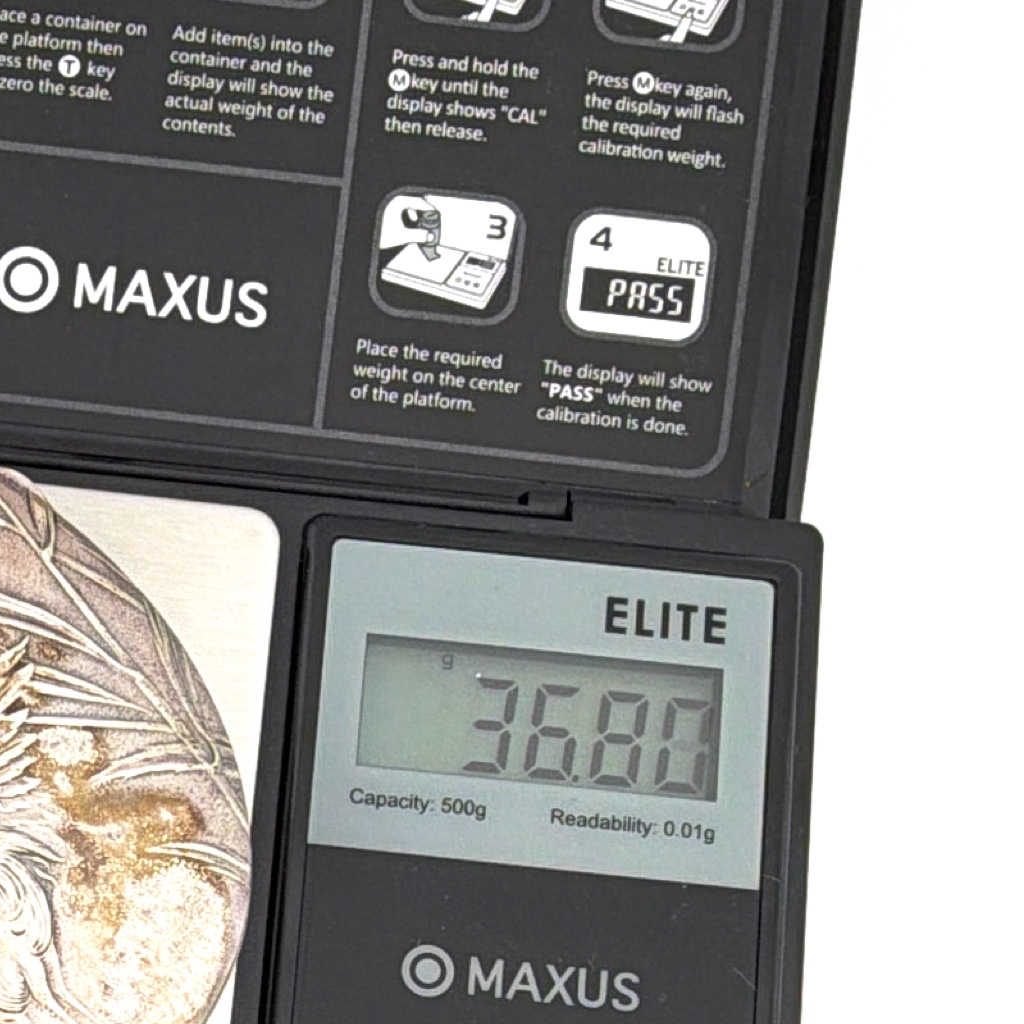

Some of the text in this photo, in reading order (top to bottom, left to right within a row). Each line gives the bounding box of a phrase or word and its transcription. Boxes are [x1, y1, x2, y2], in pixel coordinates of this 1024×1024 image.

[30, 12, 40, 25] a
[45, 12, 122, 36] container
[126, 22, 148, 37] on
[12, 30, 81, 52] platform
[87, 39, 124, 57] then
[172, 25, 335, 58] Add item(s) into the
[26, 54, 53, 72] the
[87, 61, 116, 81] key
[170, 50, 313, 78] container and the
[393, 49, 539, 80] Press and hold the
[38, 79, 65, 96] the
[69, 83, 113, 101] scale.
[167, 72, 335, 102] display will show the
[411, 76, 439, 96] key
[442, 80, 478, 96] until
[482, 82, 509, 98] the
[587, 70, 629, 90] Press
[654, 78, 682, 97] key
[685, 83, 733, 103] again,
[164, 95, 326, 124] actual weight of the
[386, 94, 547, 125] display shows "CAL"
[585, 93, 744, 125] the display will flash
[161, 118, 236, 138] contents.
[384, 118, 487, 142] then release.
[582, 116, 681, 143] the required
[578, 139, 726, 169] calibration weight.
[485, 214, 507, 239] 3
[590, 226, 613, 251] 4
[657, 257, 705, 277] ELITE
[73, 263, 269, 328] MAXUS
[607, 278, 683, 315] PASS
[356, 338, 503, 370] Place the required
[353, 362, 521, 395] weight on the center
[544, 359, 713, 393] The display will show
[350, 385, 475, 413] of the platform.
[540, 382, 682, 412] "PASS" when the
[536, 406, 689, 437] calibration is done.
[604, 596, 728, 645] ELITE
[442, 653, 454, 670] g
[462, 677, 714, 794] 36.80
[349, 788, 487, 820] Capacity: 500g
[550, 808, 715, 844] Readability: 0.01g
[467, 956, 641, 1013] MAXUS
